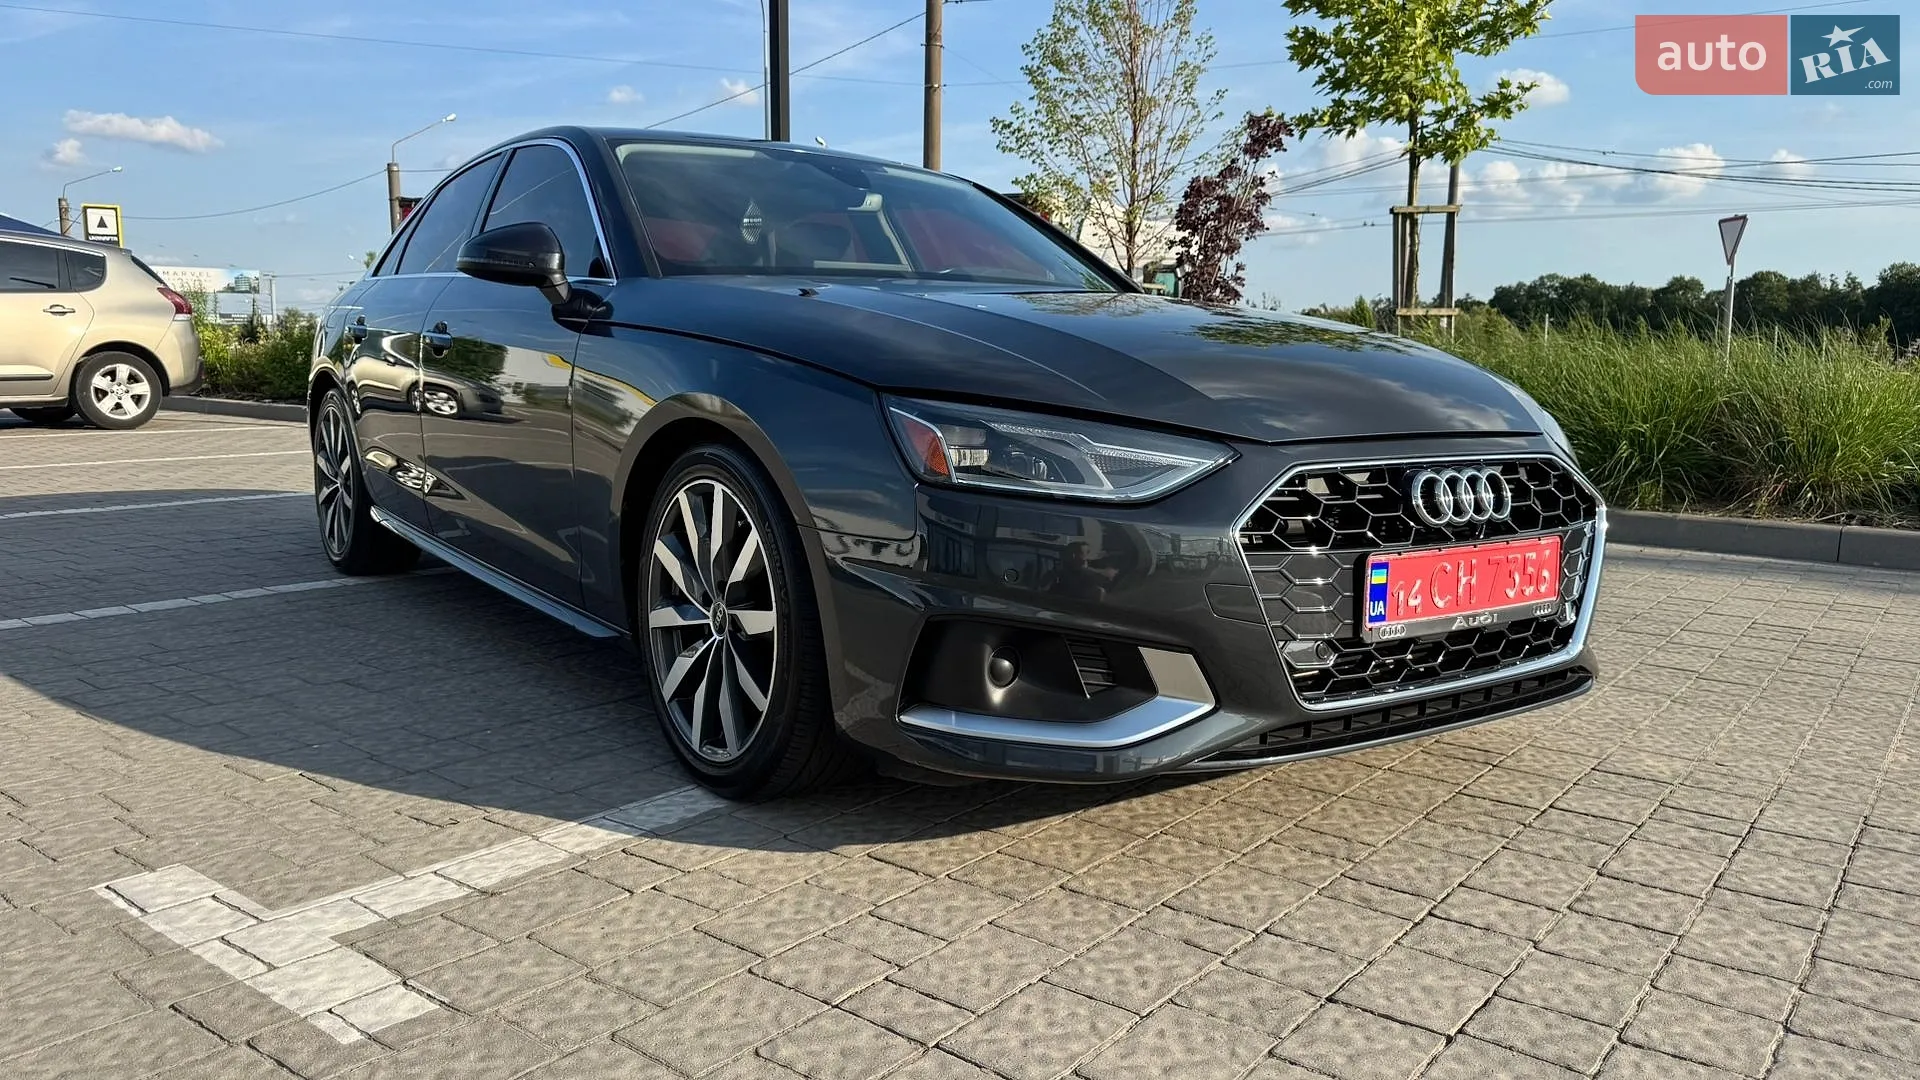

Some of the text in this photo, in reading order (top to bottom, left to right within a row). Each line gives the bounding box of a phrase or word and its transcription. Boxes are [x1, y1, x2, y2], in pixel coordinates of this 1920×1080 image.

[1391, 549, 1550, 616] 14 CH 7356
[1370, 601, 1384, 616] UA
